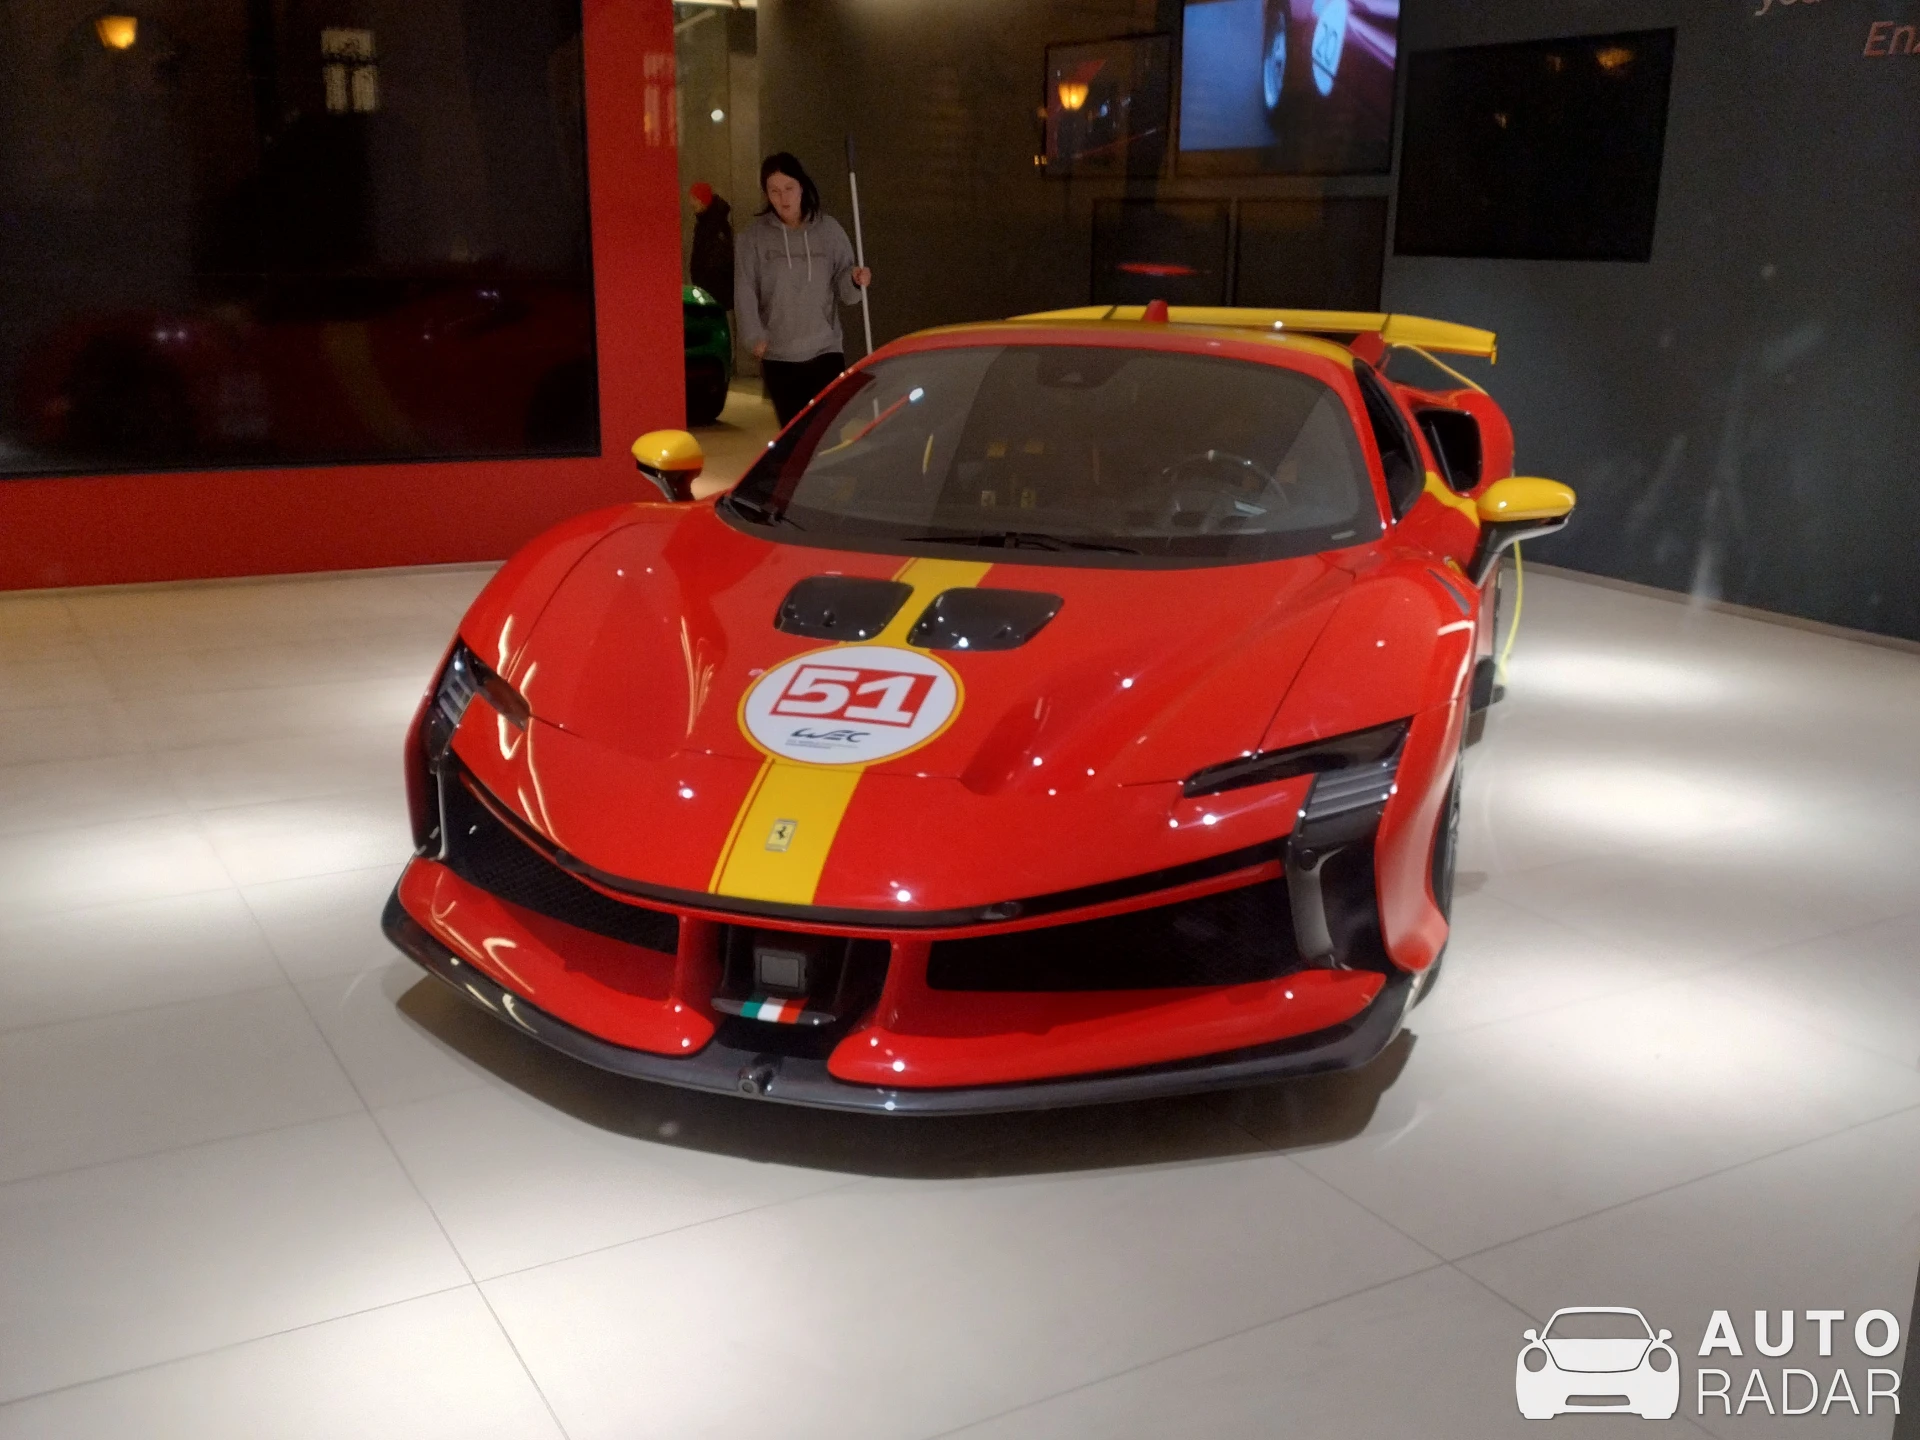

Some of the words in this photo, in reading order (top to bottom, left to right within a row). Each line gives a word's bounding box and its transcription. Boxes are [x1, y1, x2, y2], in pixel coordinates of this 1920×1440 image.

[1316, 22, 1338, 66] 20
[775, 668, 917, 724] 51
[790, 727, 871, 743] WEC
